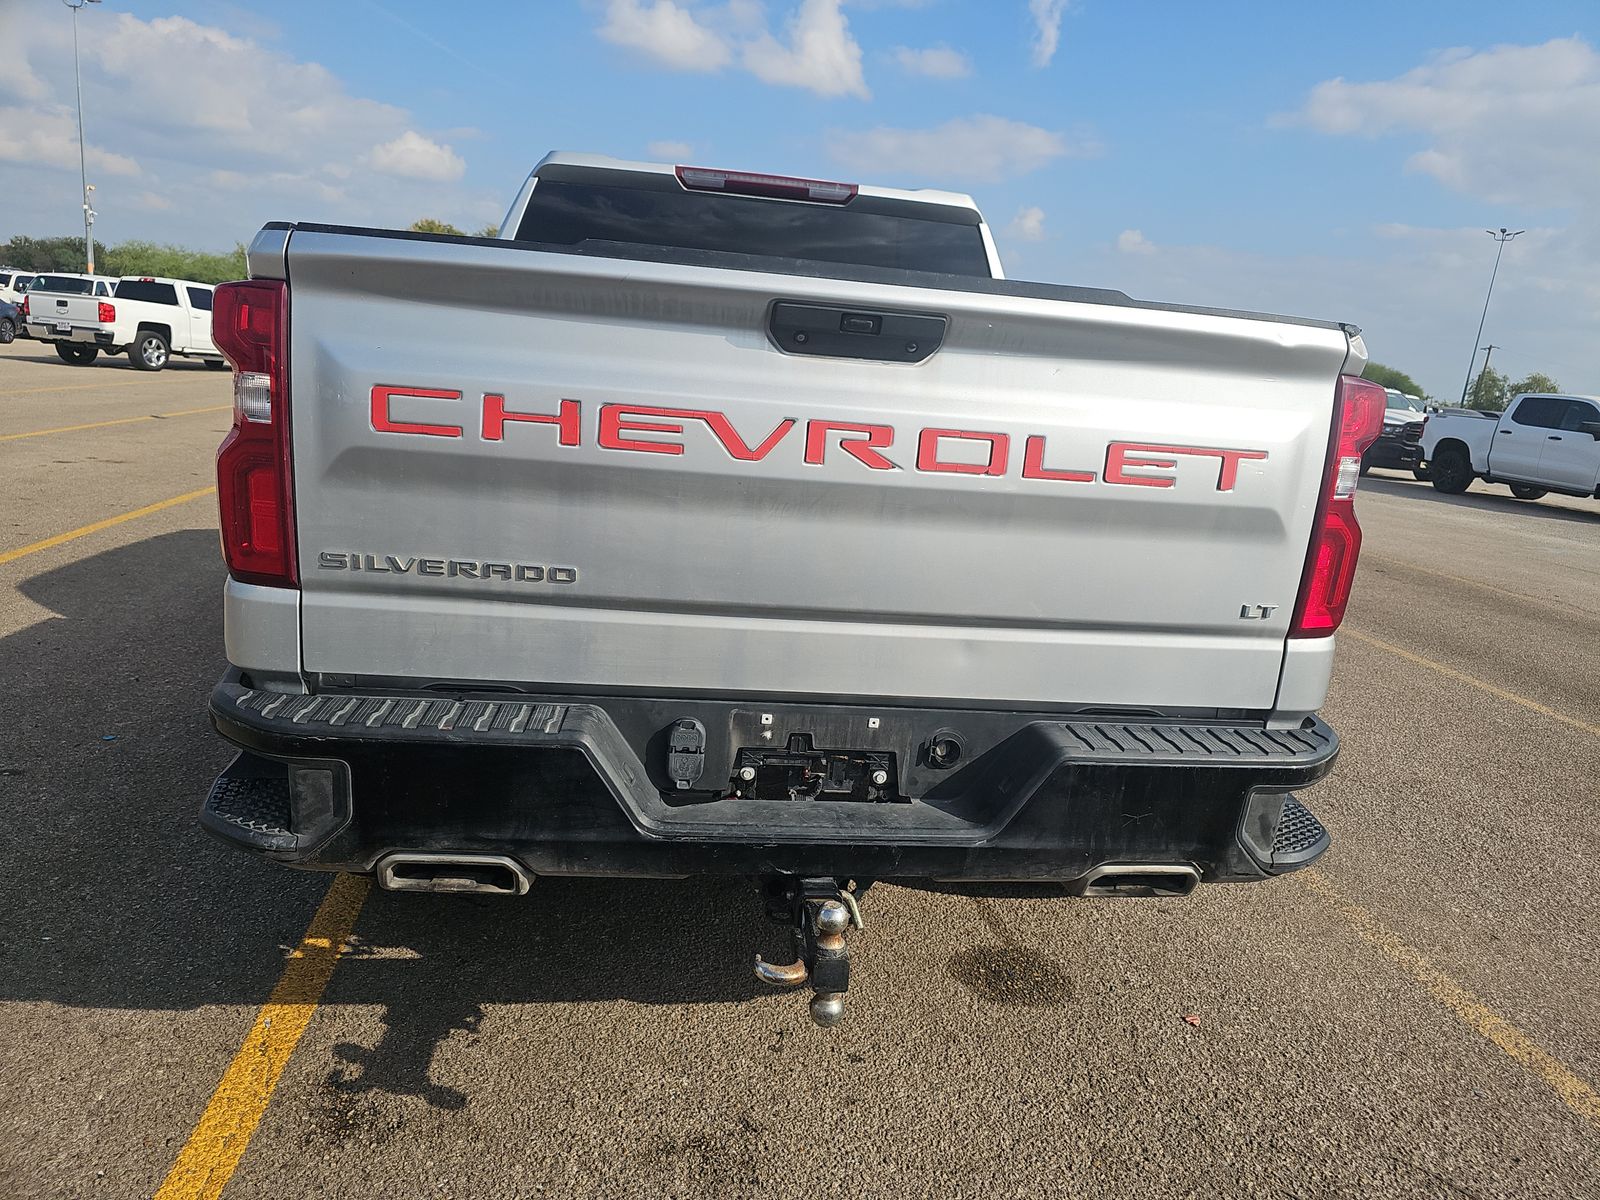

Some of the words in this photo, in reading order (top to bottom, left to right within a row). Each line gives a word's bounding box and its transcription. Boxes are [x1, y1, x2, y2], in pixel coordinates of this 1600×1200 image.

[370, 384, 1268, 492] CHEVROLET
[318, 551, 577, 584] SILVERADO
[1239, 603, 1279, 620] LT
